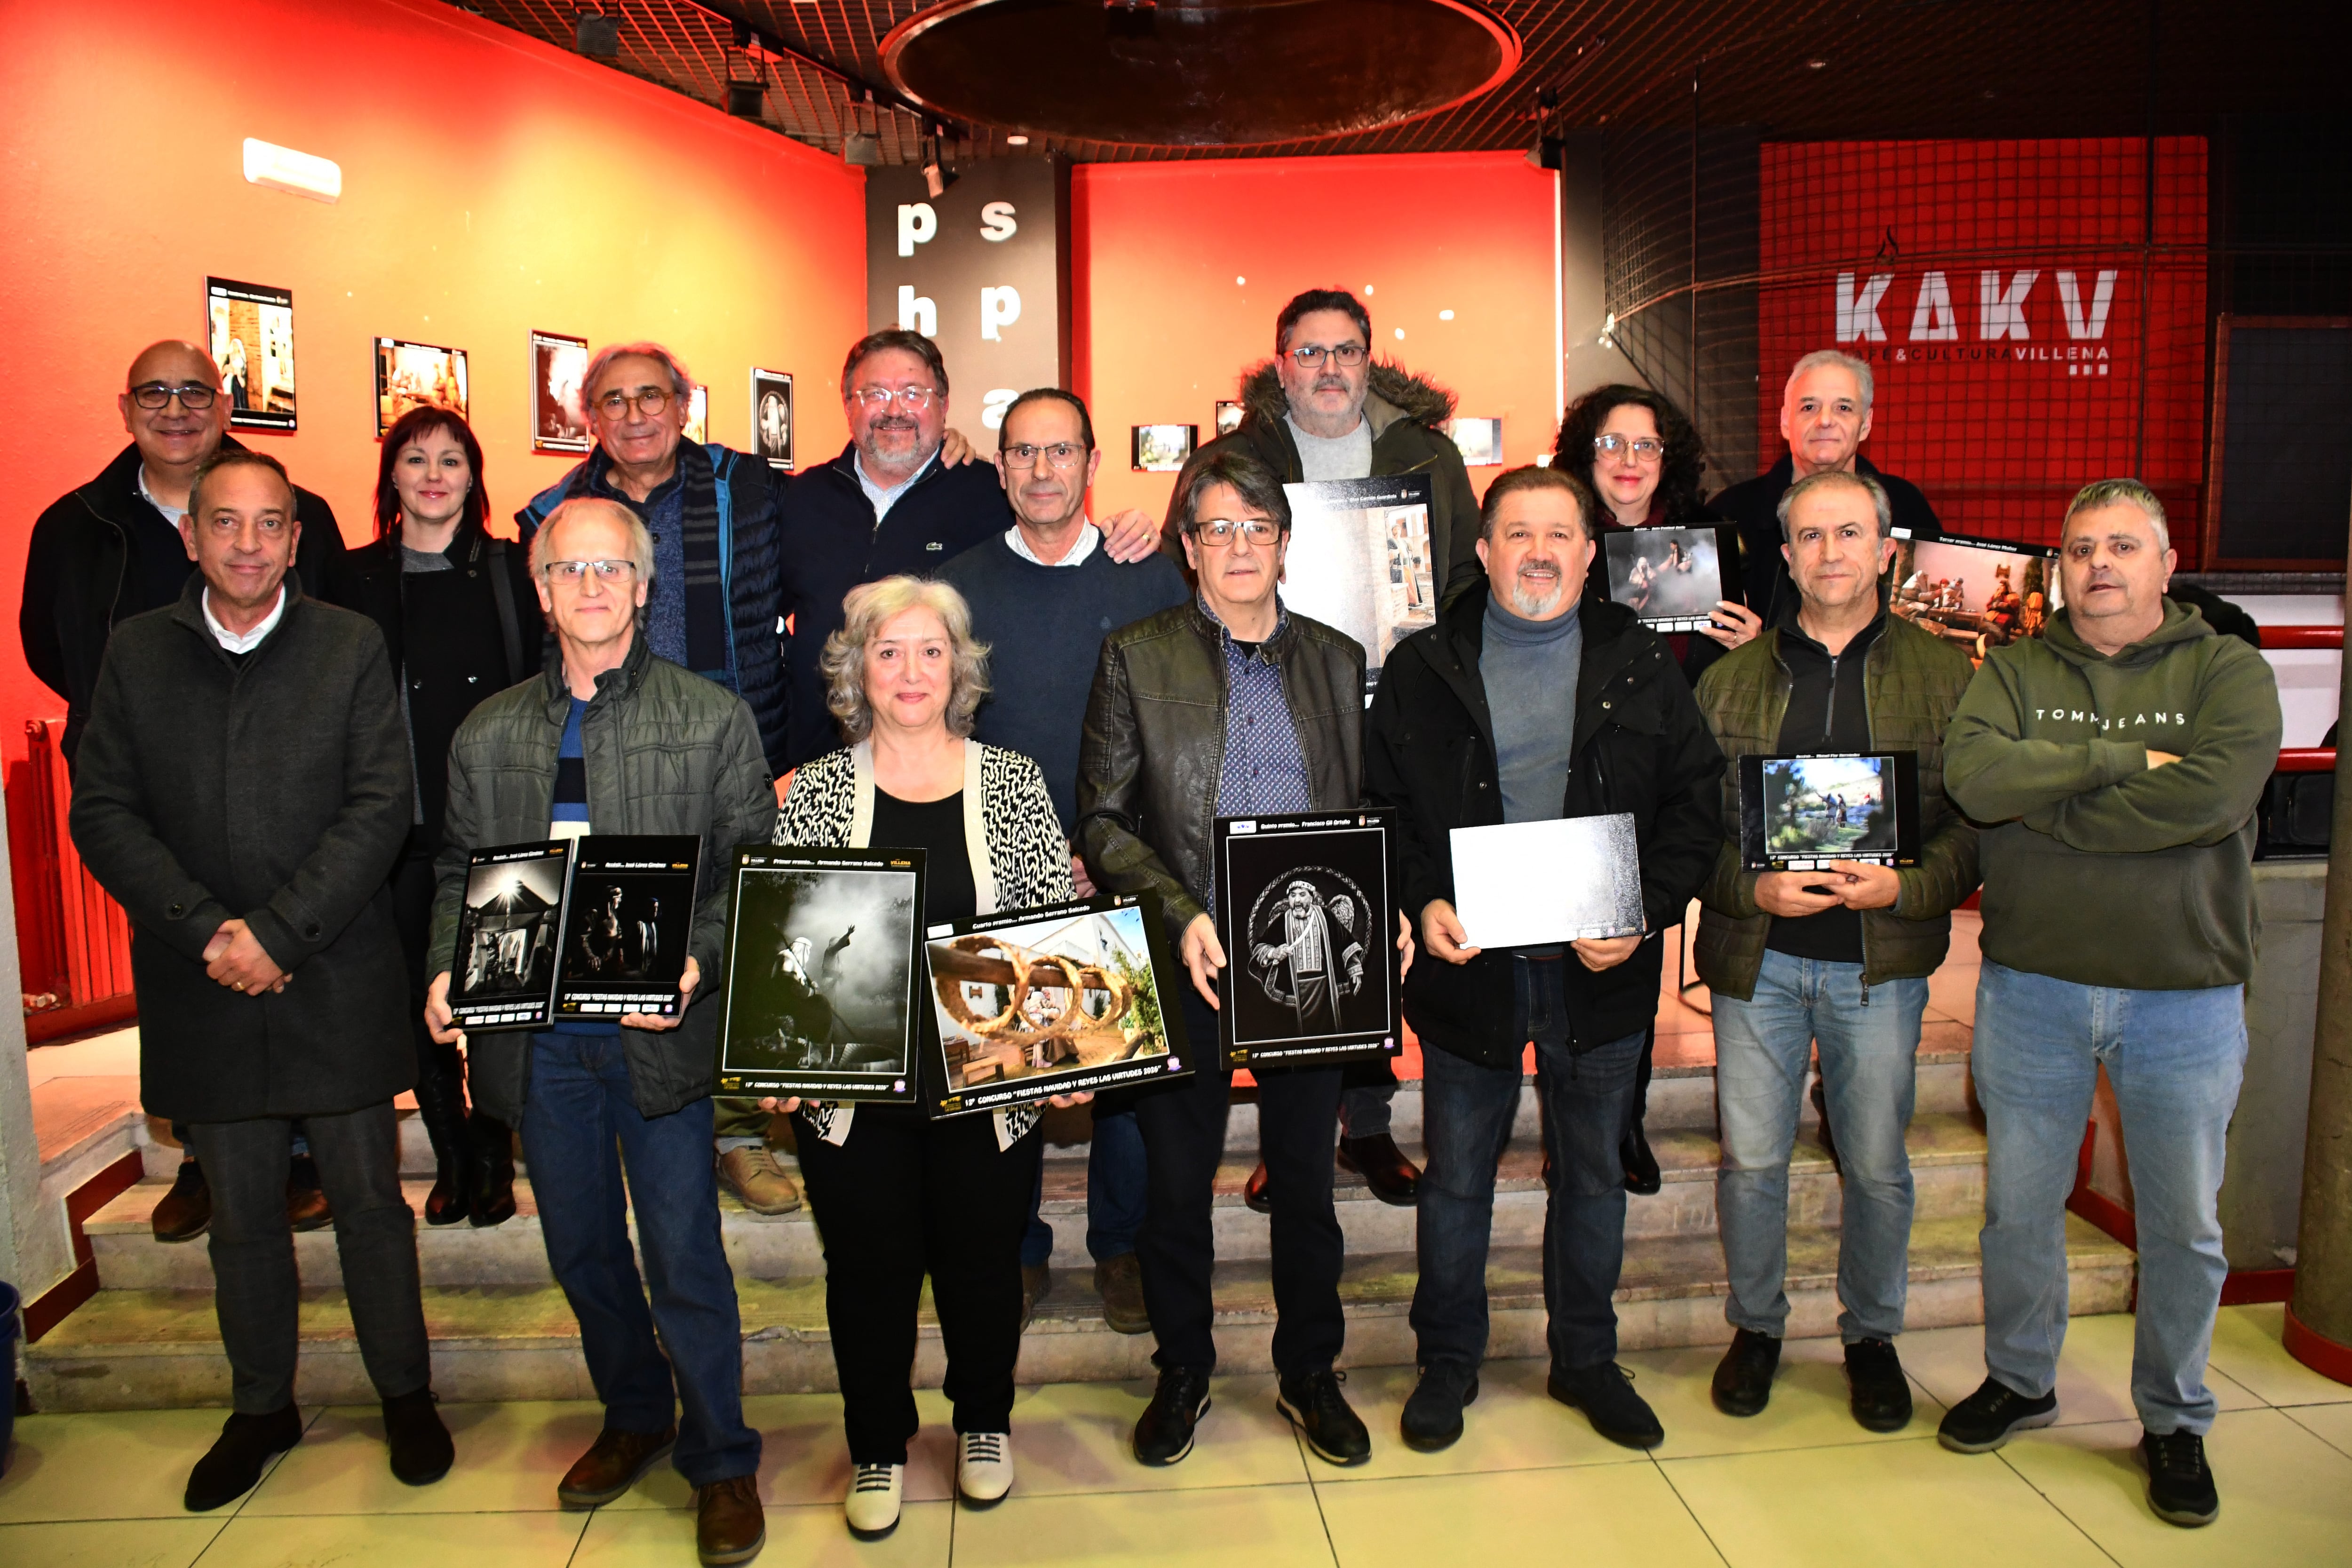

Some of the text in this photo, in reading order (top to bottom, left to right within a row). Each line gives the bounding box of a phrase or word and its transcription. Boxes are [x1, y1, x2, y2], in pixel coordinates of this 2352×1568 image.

[1836, 270, 2117, 342] KAKV
[2035, 709, 2185, 730] TOMM JEANS
[1018, 913, 1044, 922] Armando
[1045, 908, 1067, 918] Serrano
[1068, 905, 1090, 914] Salcedo
[977, 1091, 1012, 1105] CONCURSO
[1043, 1081, 1072, 1093] NAVIDAD
[1078, 1076, 1098, 1087] REYES
[1099, 1074, 1112, 1083] LAS
[1112, 1068, 1143, 1081] VIRTUDES
[1143, 1065, 1161, 1075] 2026"
